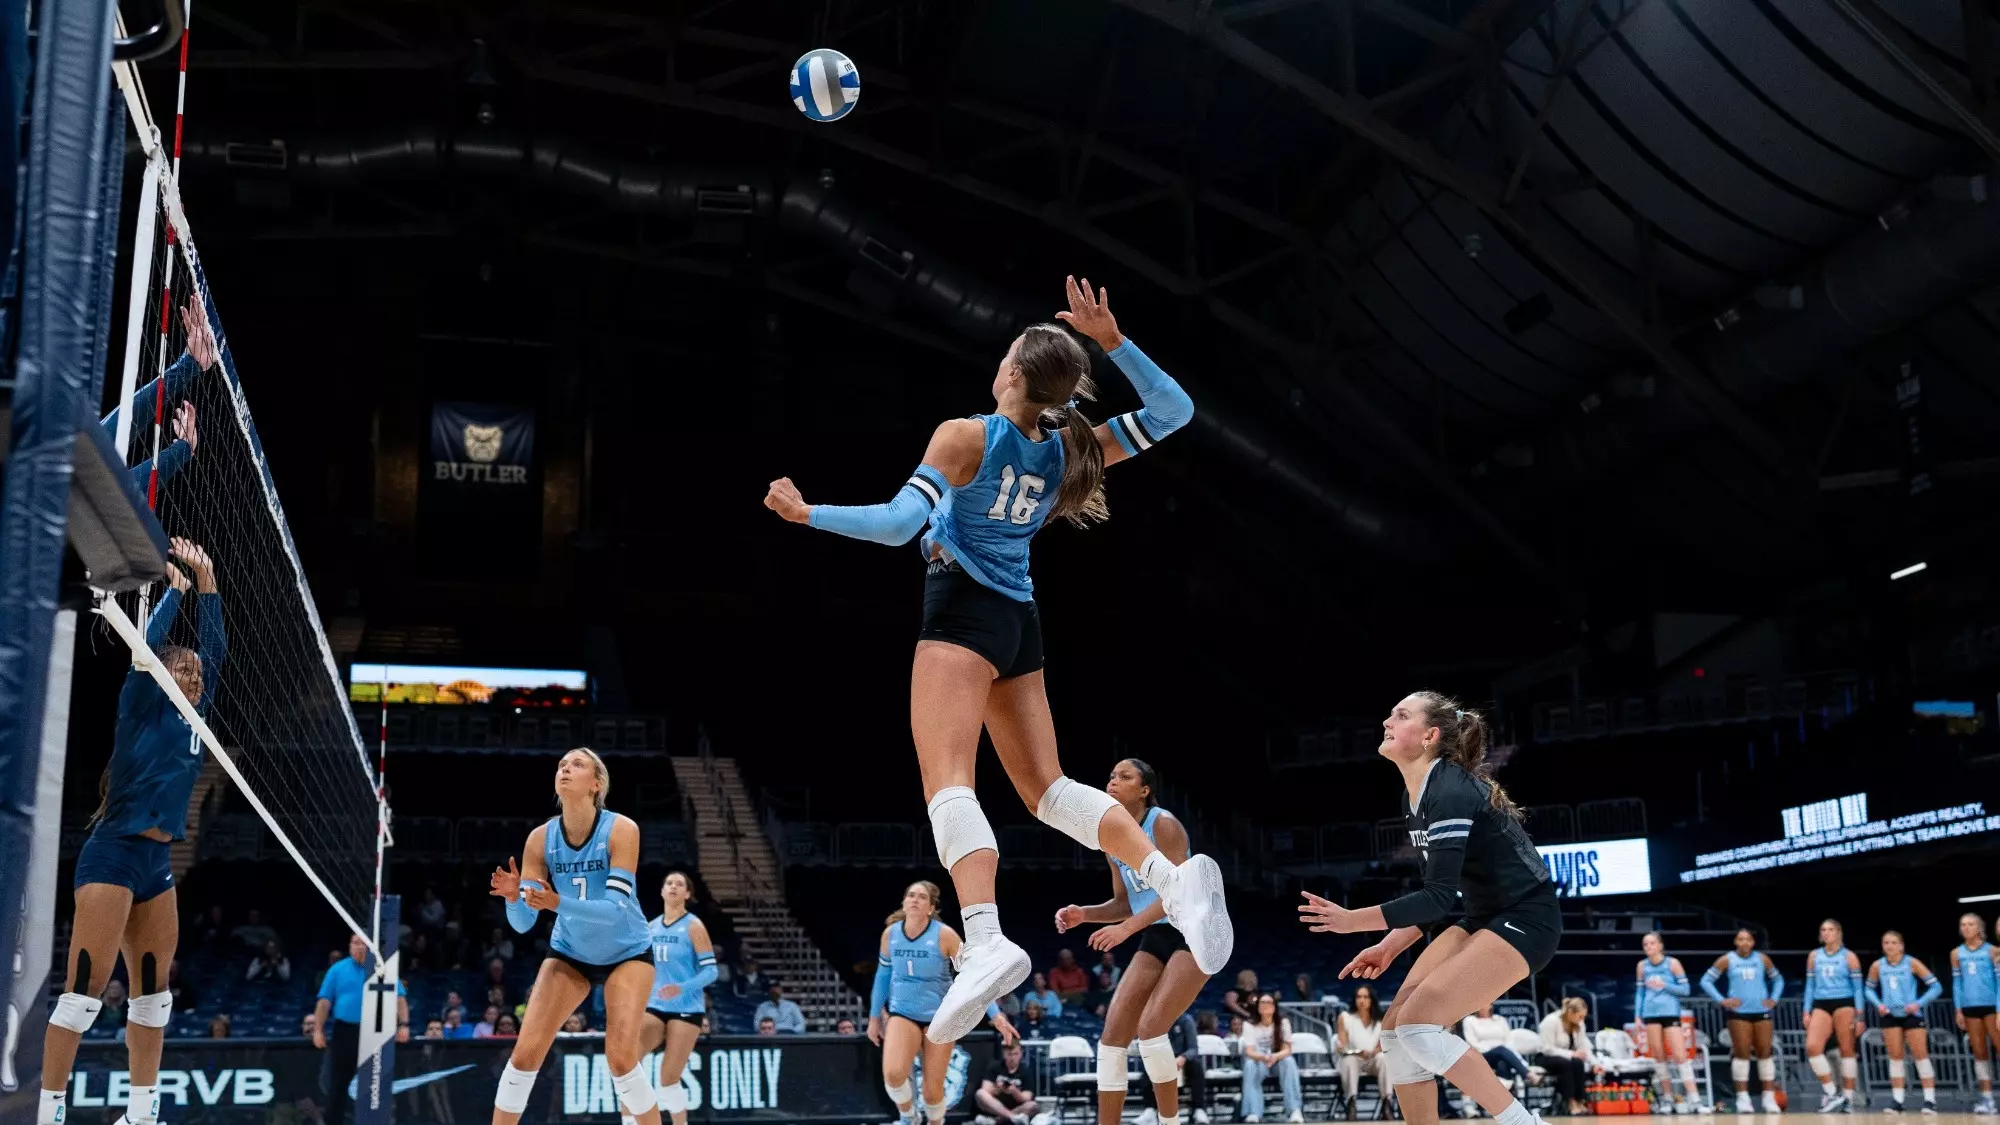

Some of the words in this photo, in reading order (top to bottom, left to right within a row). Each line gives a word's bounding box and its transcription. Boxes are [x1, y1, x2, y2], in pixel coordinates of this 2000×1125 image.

[434, 462, 527, 484] BUTLER
[987, 463, 1046, 525] 16
[1890, 811, 1937, 831] ACCEPTS
[1937, 802, 1986, 822] REALITY,
[1853, 835, 1896, 854] PUTTING
[1895, 830, 1917, 846] THE
[1916, 824, 1947, 843] TEAM
[1946, 818, 1986, 837] ABOVE
[554, 859, 605, 874] BUTLER
[571, 876, 587, 900] 7
[655, 944, 668, 962] 11
[893, 949, 930, 959] BUTLER
[906, 960, 914, 977] 1
[69, 1068, 275, 1108] LERVB
[710, 1048, 782, 1110] ONLY
